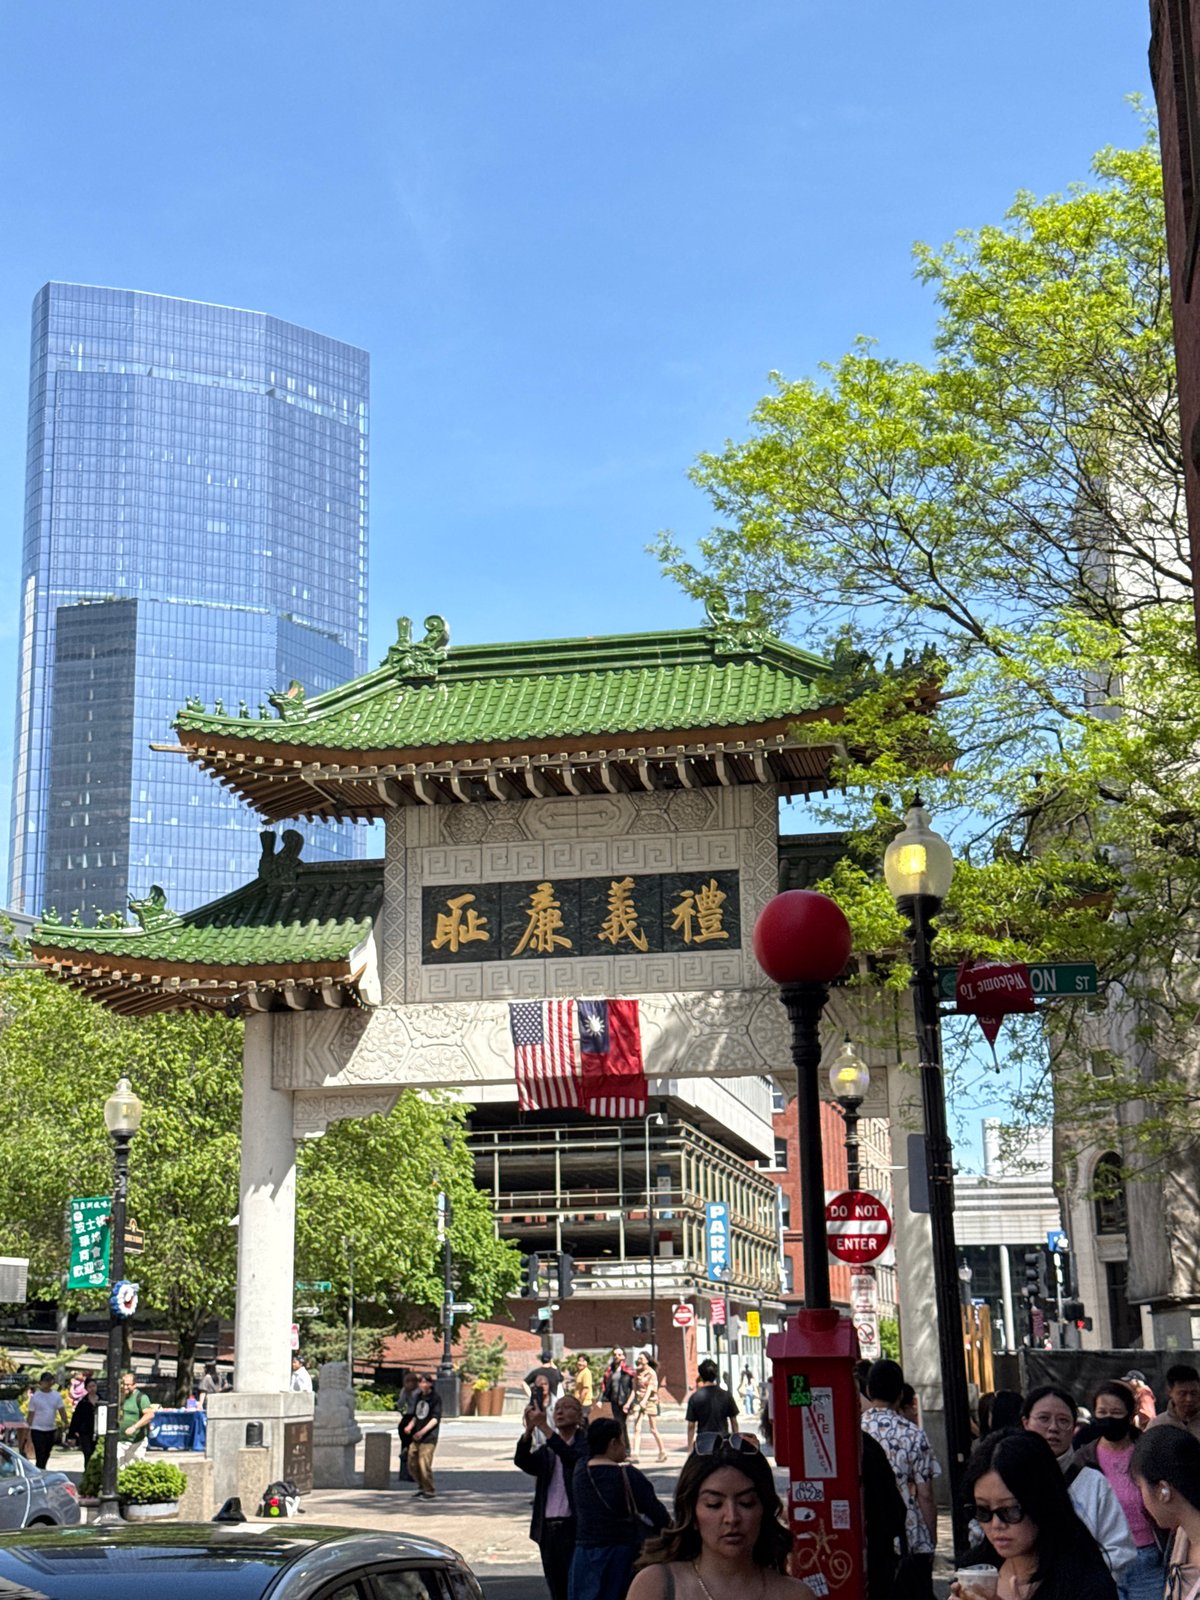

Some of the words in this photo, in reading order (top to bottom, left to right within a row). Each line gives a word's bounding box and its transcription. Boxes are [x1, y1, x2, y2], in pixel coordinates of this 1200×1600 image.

[960, 981, 977, 1000] To
[977, 972, 1027, 993] Welcome
[1029, 969, 1057, 993] ON
[1075, 975, 1090, 991] ST
[830, 1205, 848, 1218] DO
[854, 1205, 880, 1218] NOT
[709, 1205, 726, 1264] PARK
[836, 1238, 878, 1251] ENTER
[813, 1404, 830, 1434] IRE
